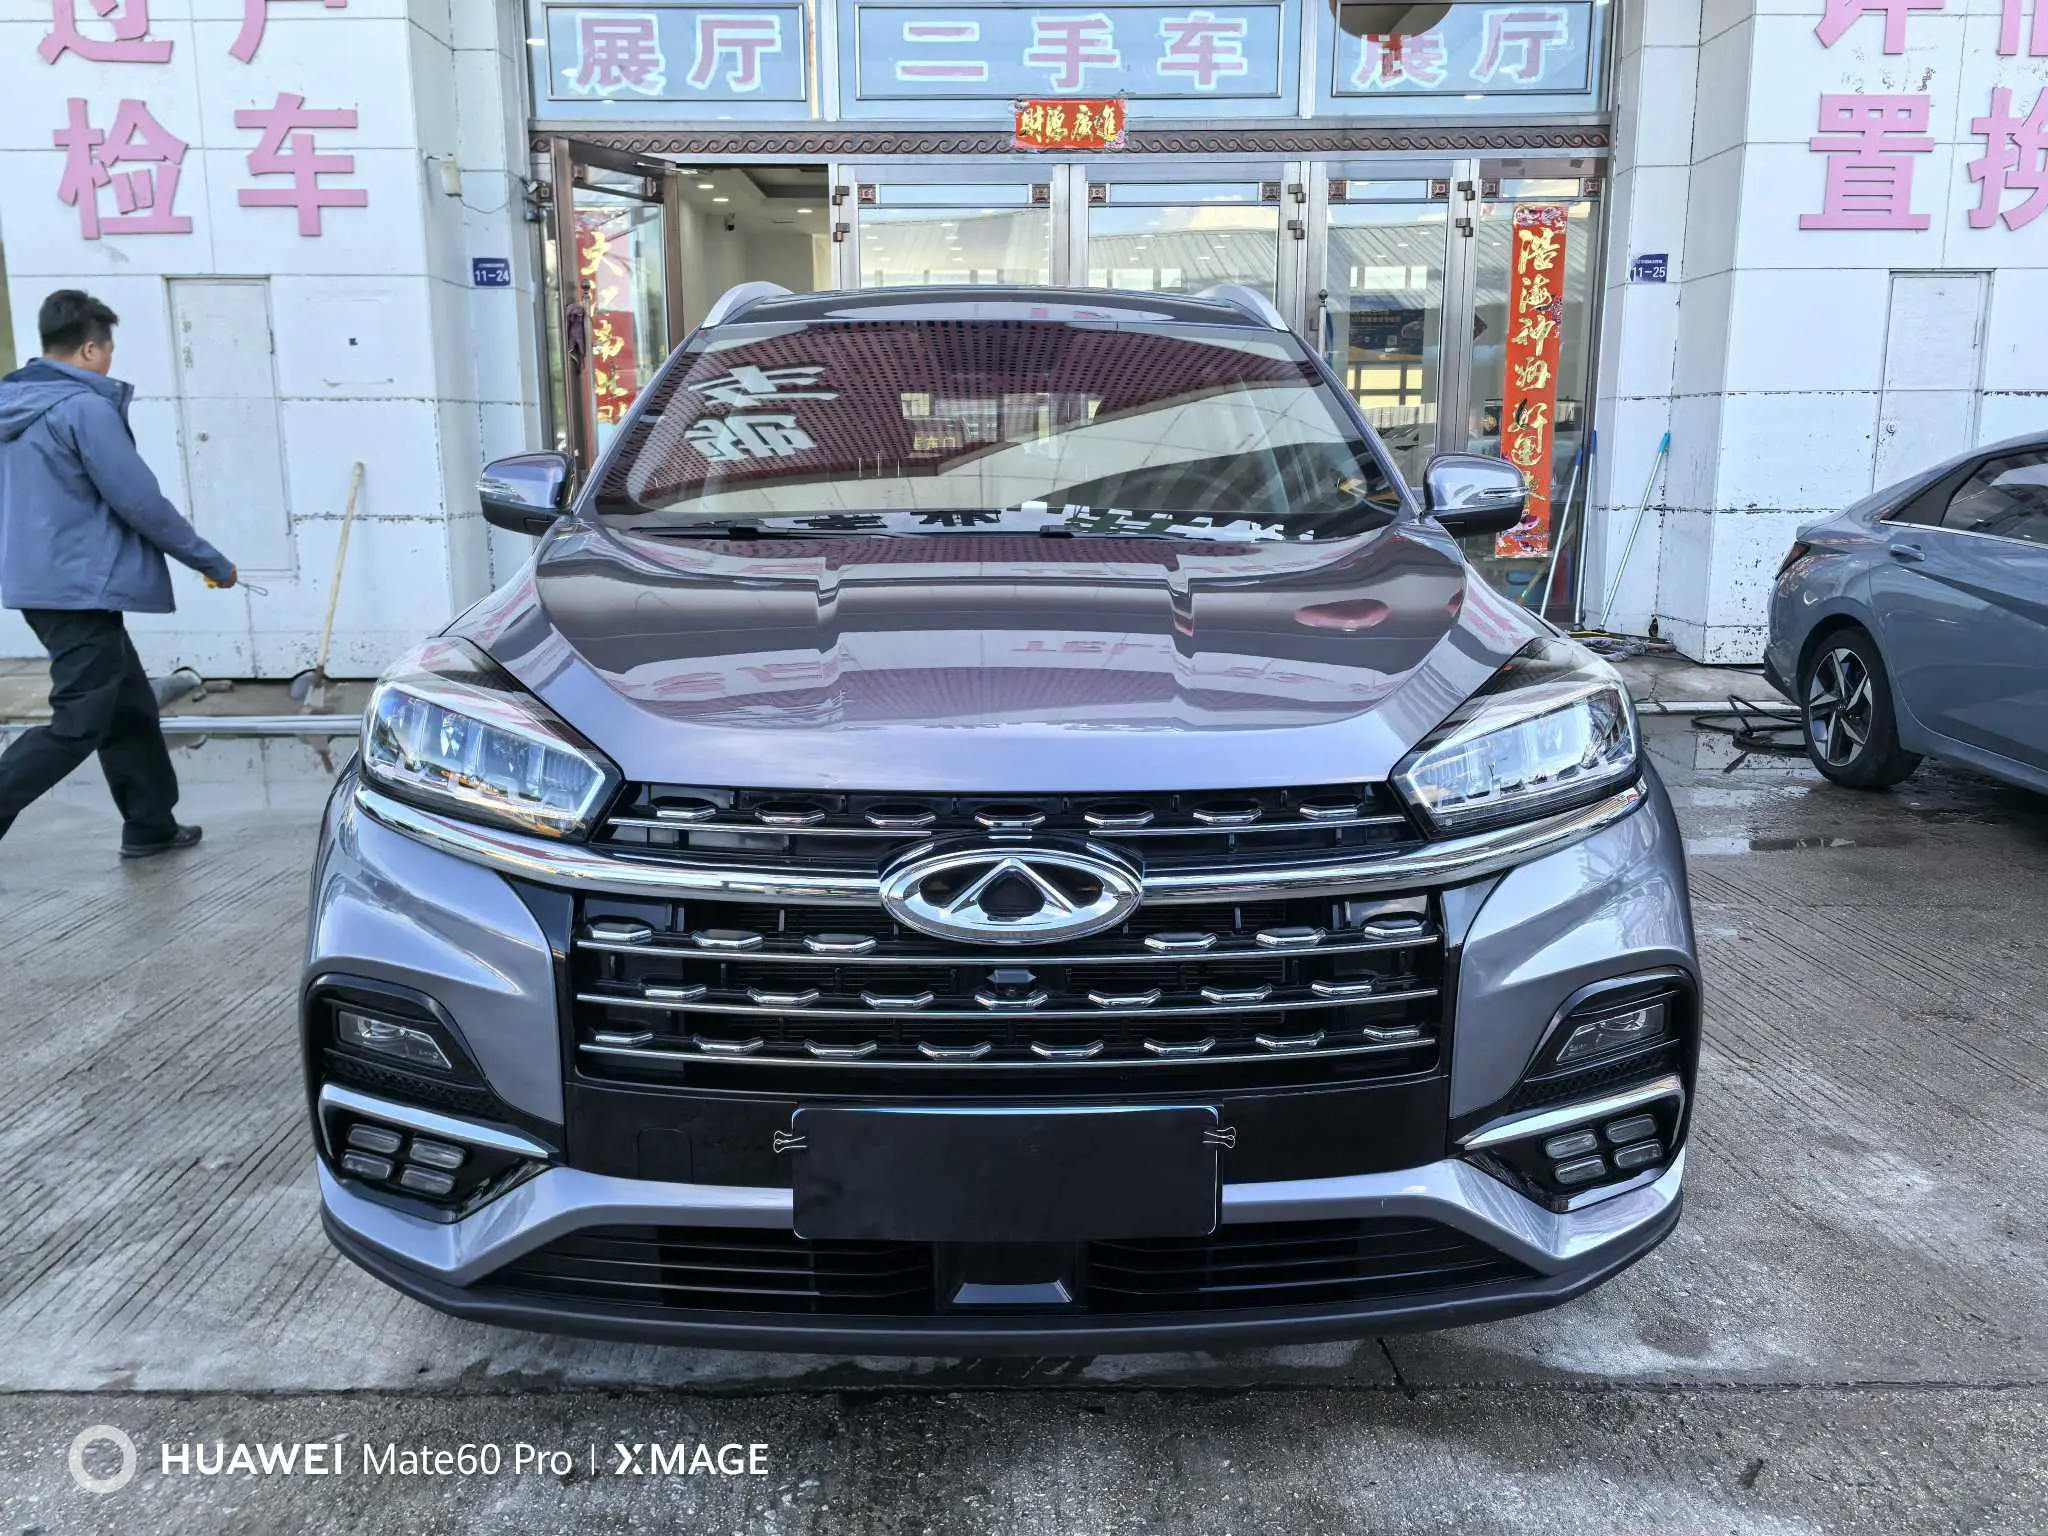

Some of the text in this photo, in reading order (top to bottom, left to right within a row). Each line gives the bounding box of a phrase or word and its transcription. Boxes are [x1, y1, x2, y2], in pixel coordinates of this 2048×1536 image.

[572, 13, 781, 94] 展厅
[898, 13, 1249, 91] 二手车
[53, 93, 367, 240] 检车
[475, 270, 510, 282] 11-24
[1632, 266, 1666, 280] 11-25
